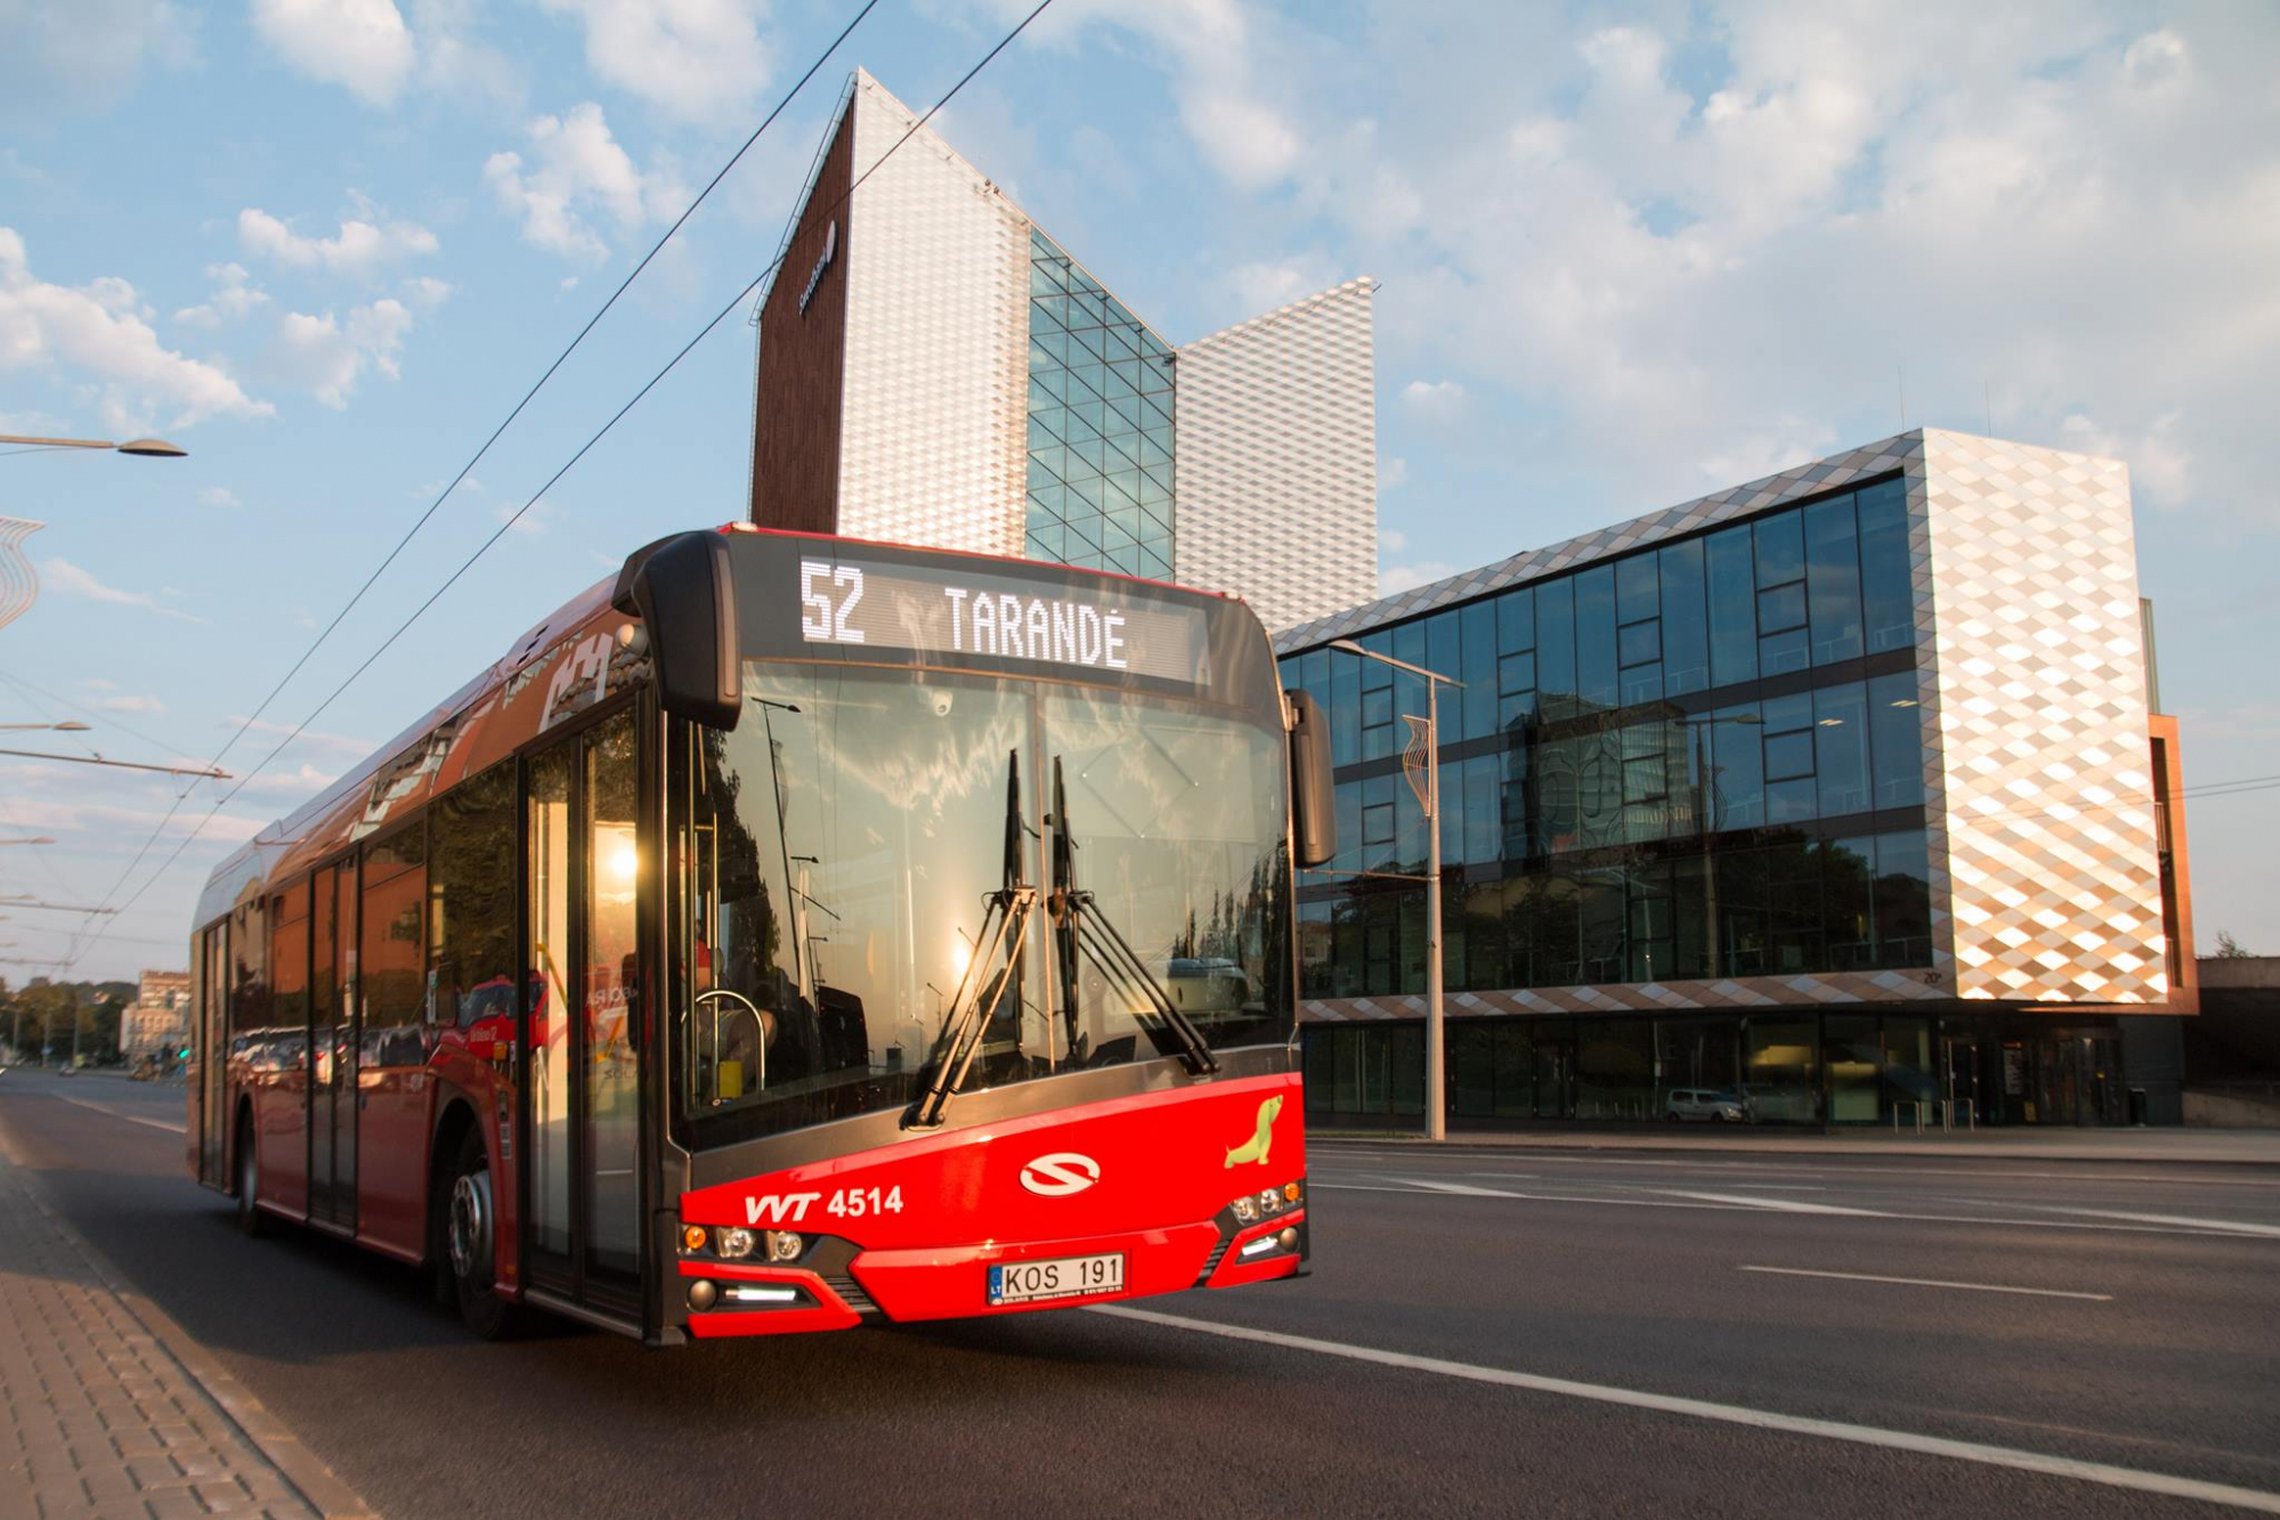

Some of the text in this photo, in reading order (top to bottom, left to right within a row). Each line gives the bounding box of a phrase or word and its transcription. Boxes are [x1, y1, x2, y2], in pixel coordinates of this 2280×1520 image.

[801, 561, 1127, 668] 52 TARANDĖ
[745, 1185, 904, 1224] VVT 4514
[991, 1285, 1002, 1295] LT
[1006, 1264, 1059, 1294] KOS
[1080, 1258, 1117, 1285] 191
